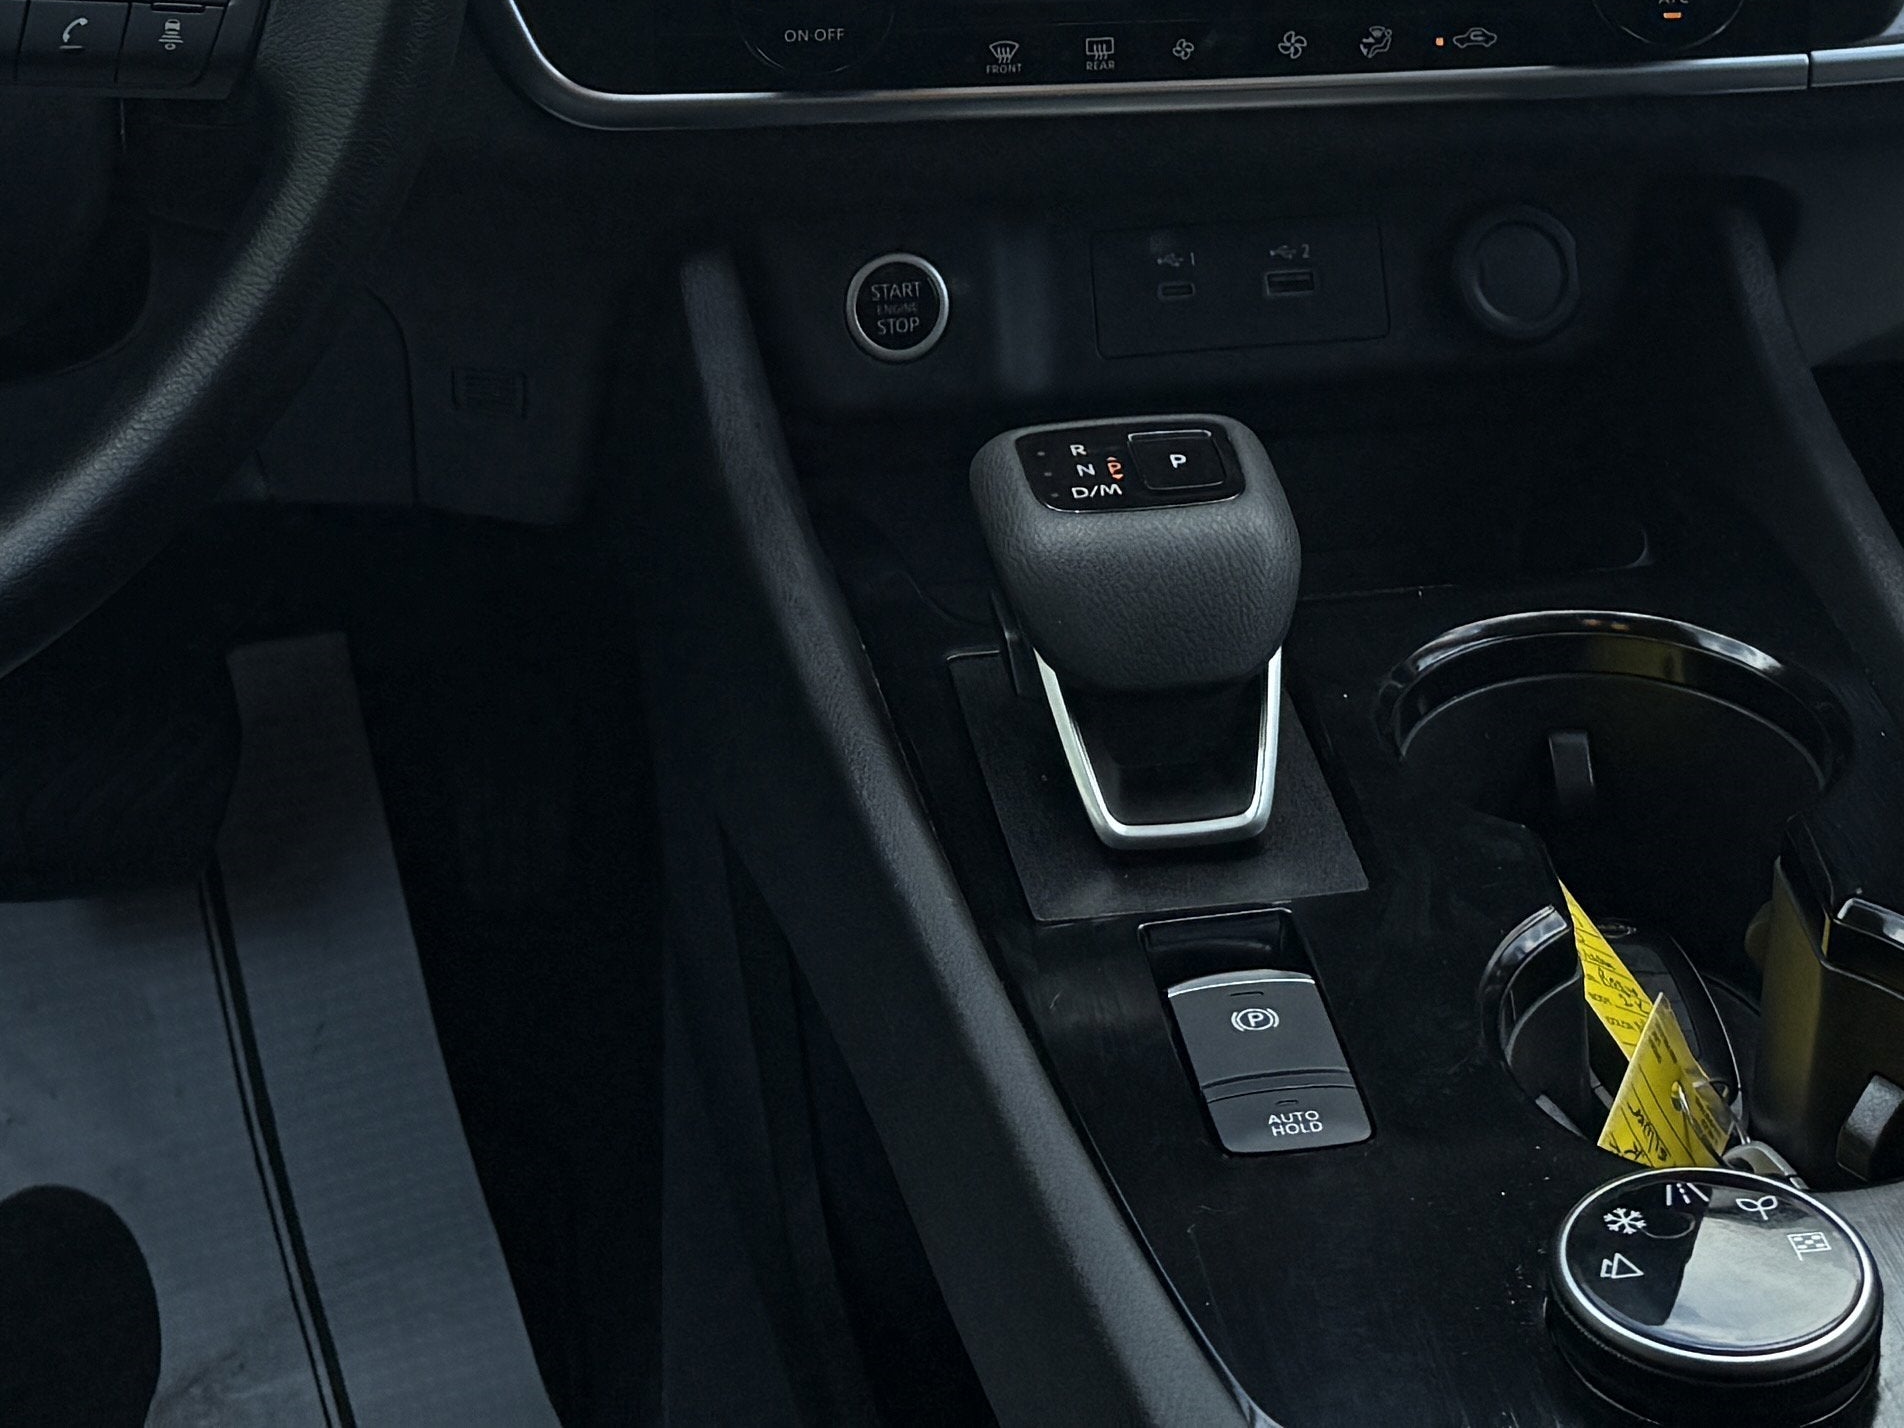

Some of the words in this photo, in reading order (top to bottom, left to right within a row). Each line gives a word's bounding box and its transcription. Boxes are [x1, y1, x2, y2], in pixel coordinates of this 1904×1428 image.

[986, 63, 1022, 75] FRONT
[1086, 59, 1116, 71] REAR
[871, 281, 921, 301] START
[877, 316, 920, 335] STOP
[1069, 444, 1088, 457] R
[1169, 453, 1187, 469] P
[1076, 463, 1096, 477] N
[1071, 482, 1123, 498] D/M
[1267, 1108, 1320, 1126] AUTO
[1270, 1119, 1324, 1136] HOLD
